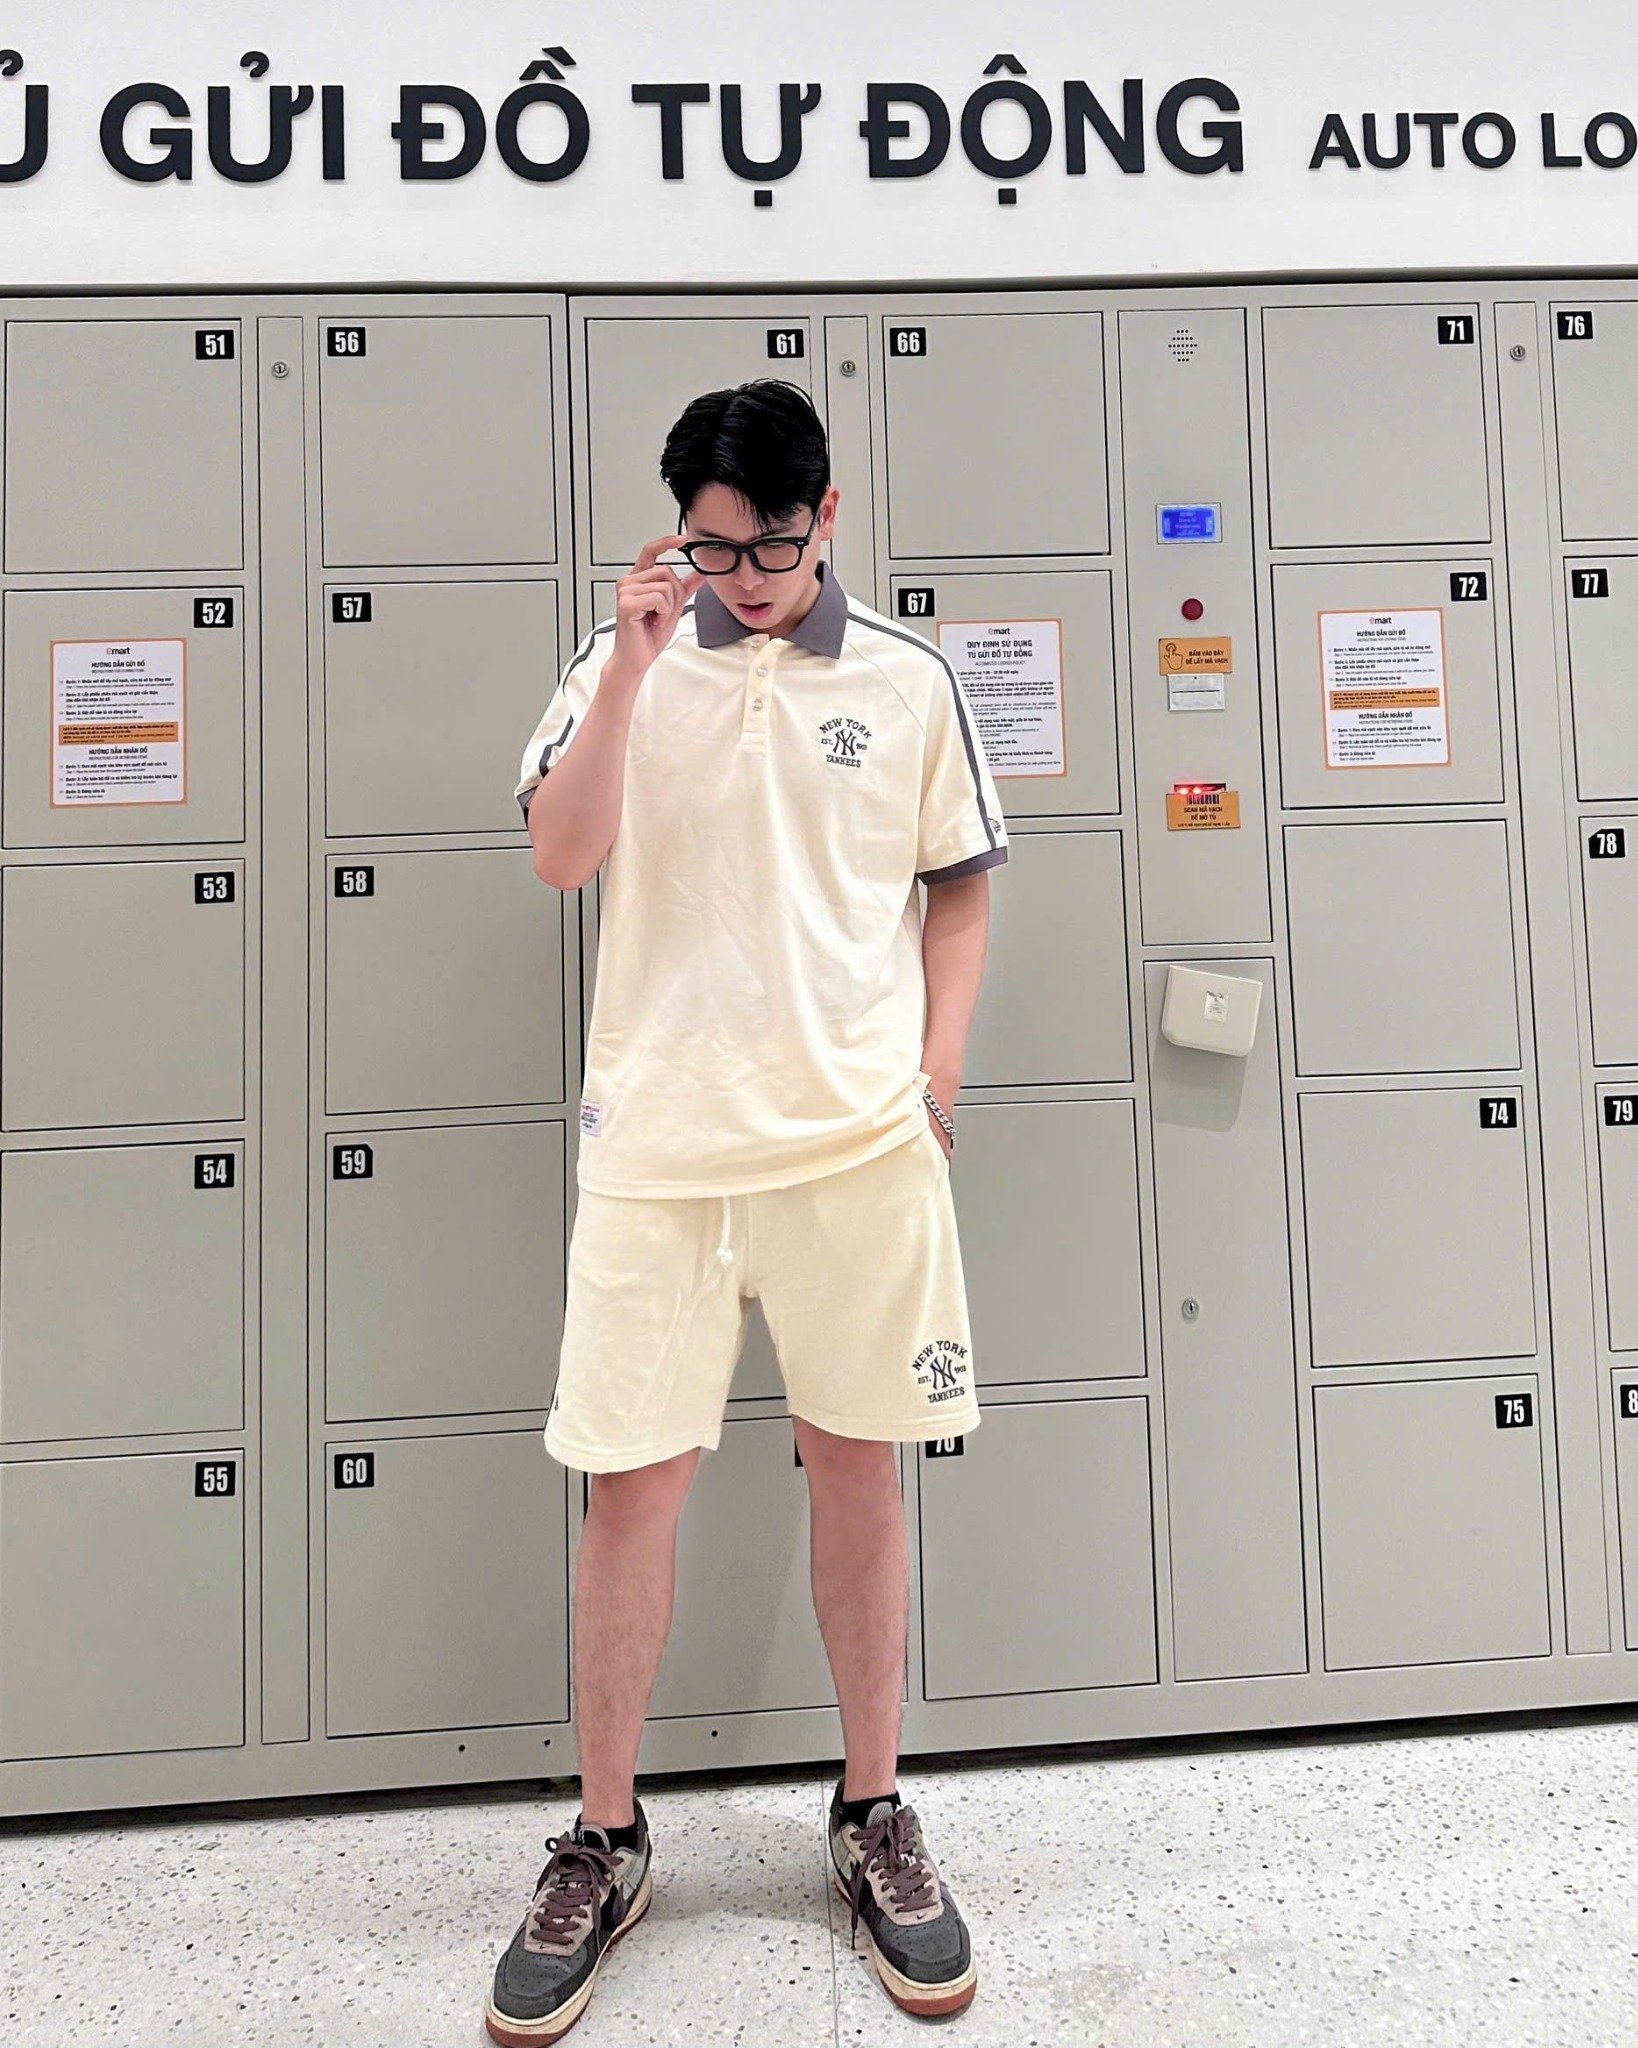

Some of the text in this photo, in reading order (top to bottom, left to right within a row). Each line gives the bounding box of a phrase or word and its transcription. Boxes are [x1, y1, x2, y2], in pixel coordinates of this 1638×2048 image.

[98, 49, 347, 184] GỬI
[390, 45, 592, 184] ĐỒ
[630, 81, 824, 207] TỰ
[858, 53, 1245, 206] ĐỘNG
[1308, 111, 1638, 171] AUTO LO
[1445, 319, 1466, 342] 71
[1563, 314, 1587, 337] 76
[204, 333, 227, 357] 51
[334, 330, 360, 354] 56
[775, 332, 797, 356] 61
[896, 330, 921, 355] 66
[1457, 575, 1480, 599] 72
[1580, 572, 1600, 596] 77
[201, 601, 227, 626] 52
[341, 595, 364, 620] 57
[906, 591, 928, 615] 67
[819, 717, 872, 739] NEW YORK
[825, 755, 862, 768] YANKEES
[1595, 831, 1618, 856] 78
[201, 875, 228, 901] 53
[341, 869, 368, 895] 58
[1487, 1101, 1510, 1126] 74
[1612, 1099, 1634, 1123] 79
[202, 1158, 228, 1185] 54
[340, 1148, 367, 1176] 59
[912, 1340, 968, 1371] NEW YORK
[927, 1386, 966, 1403] YANKEES
[1502, 1398, 1526, 1425] 75
[202, 1465, 229, 1494] 55
[341, 1457, 368, 1486] 60
